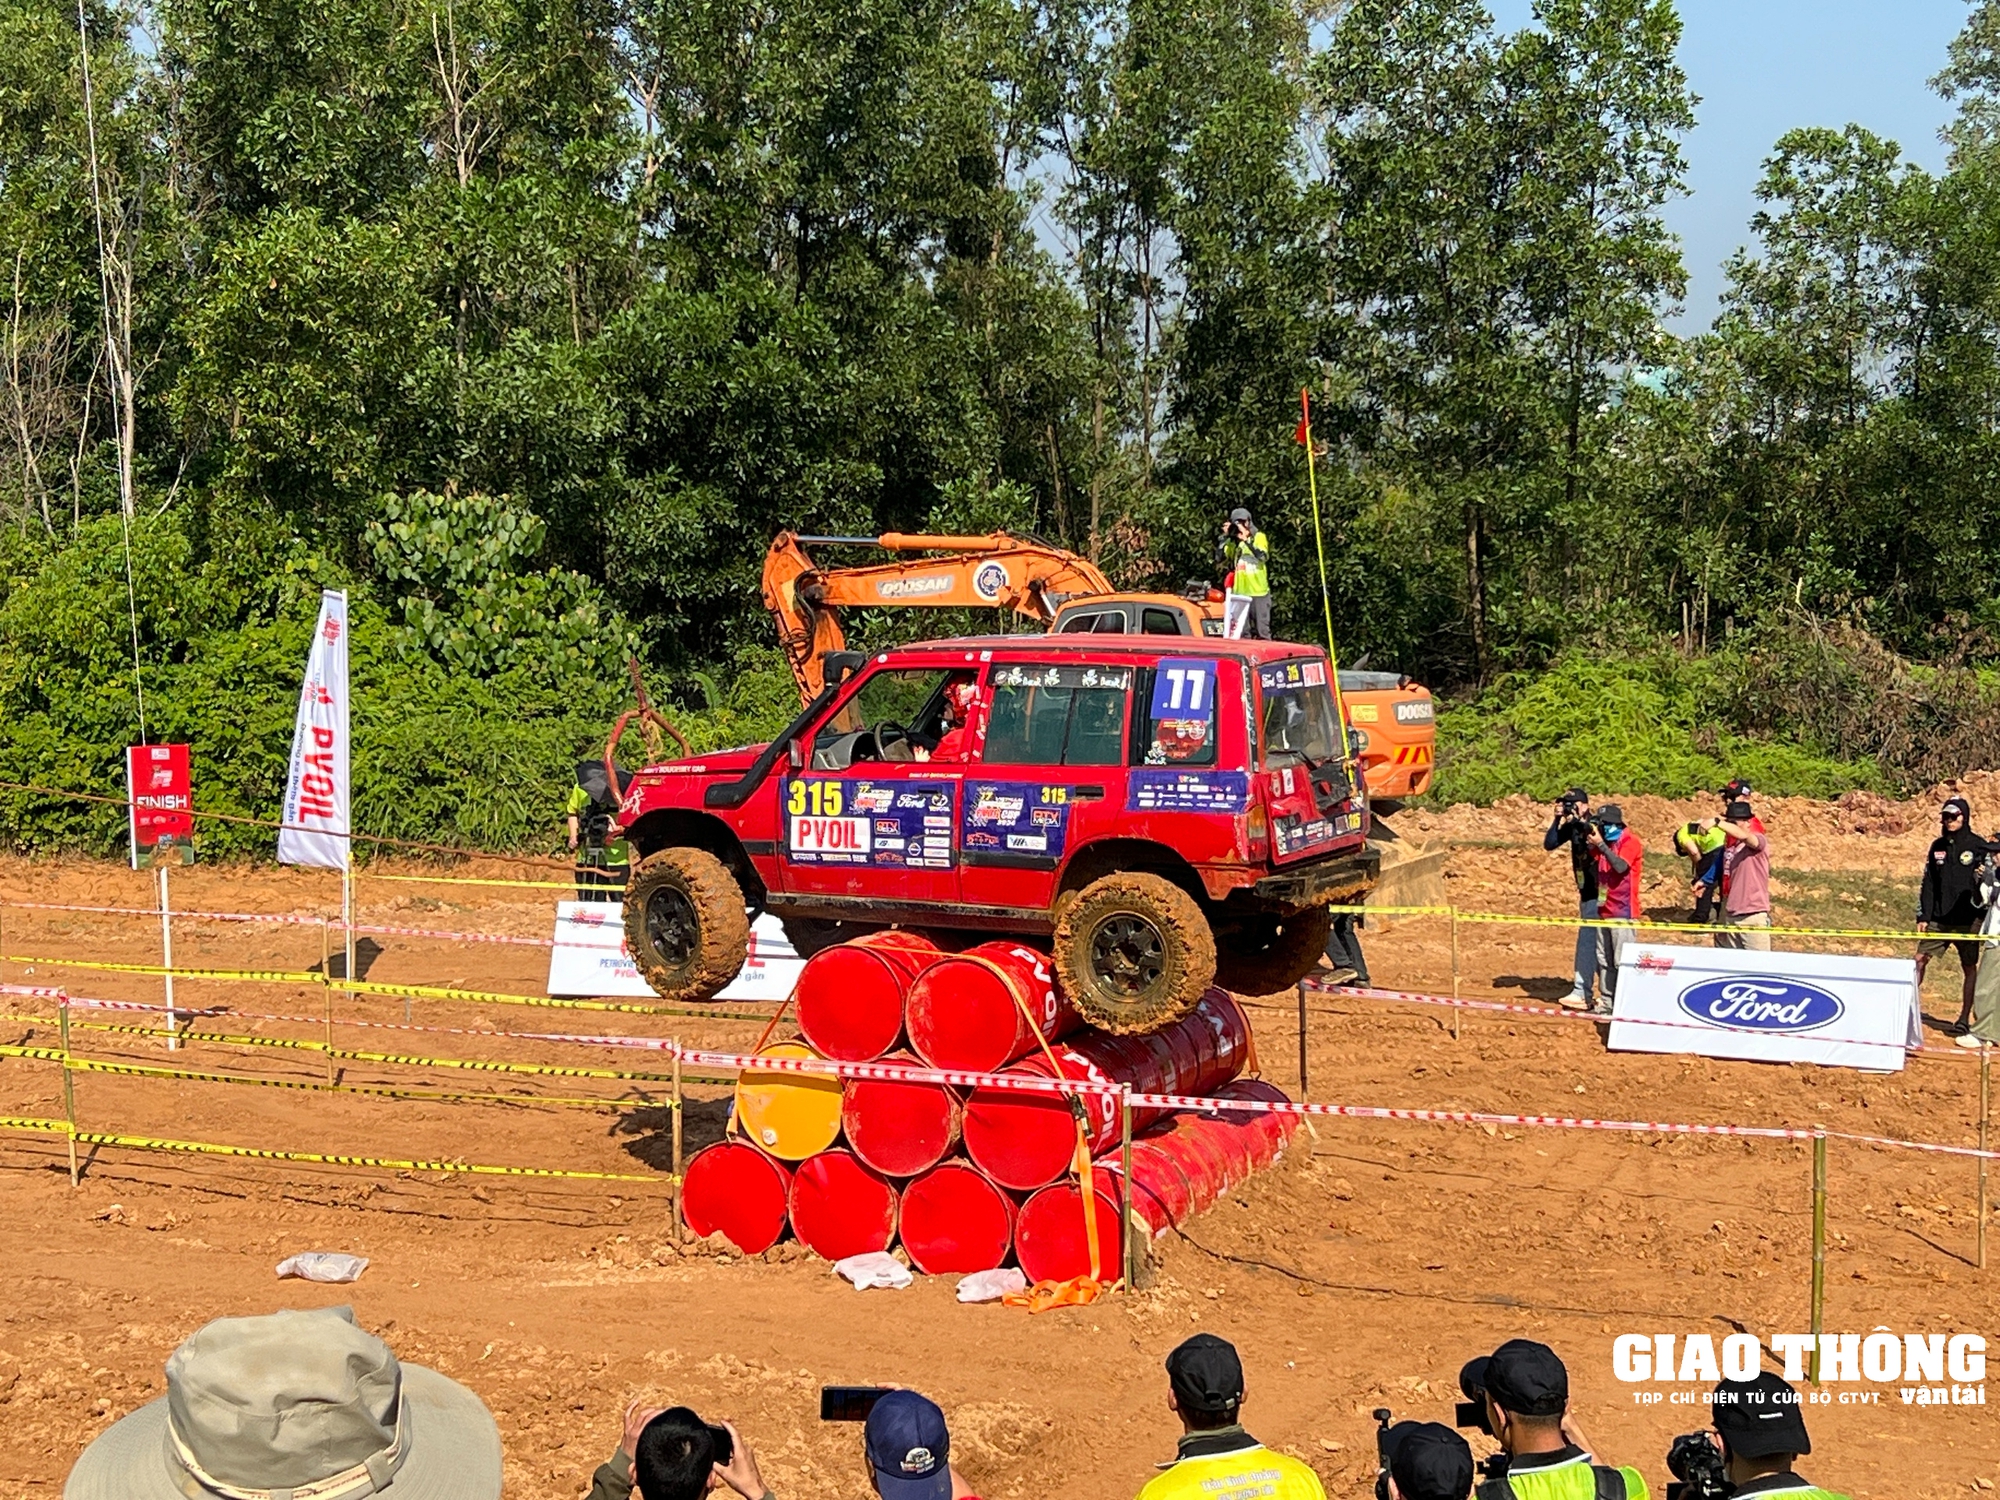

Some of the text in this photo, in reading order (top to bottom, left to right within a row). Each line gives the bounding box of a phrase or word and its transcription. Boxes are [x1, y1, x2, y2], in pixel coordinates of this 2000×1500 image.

[882, 577, 949, 595] DOOSAN
[1397, 703, 1433, 721] DOOSA
[300, 726, 334, 823] PVOIL
[136, 795, 187, 810] FINISH
[788, 780, 842, 816] 315
[897, 794, 926, 809] Ford
[1041, 787, 1067, 804] 315
[797, 819, 862, 849] PVOIL
[1709, 983, 1811, 1025] Ford
